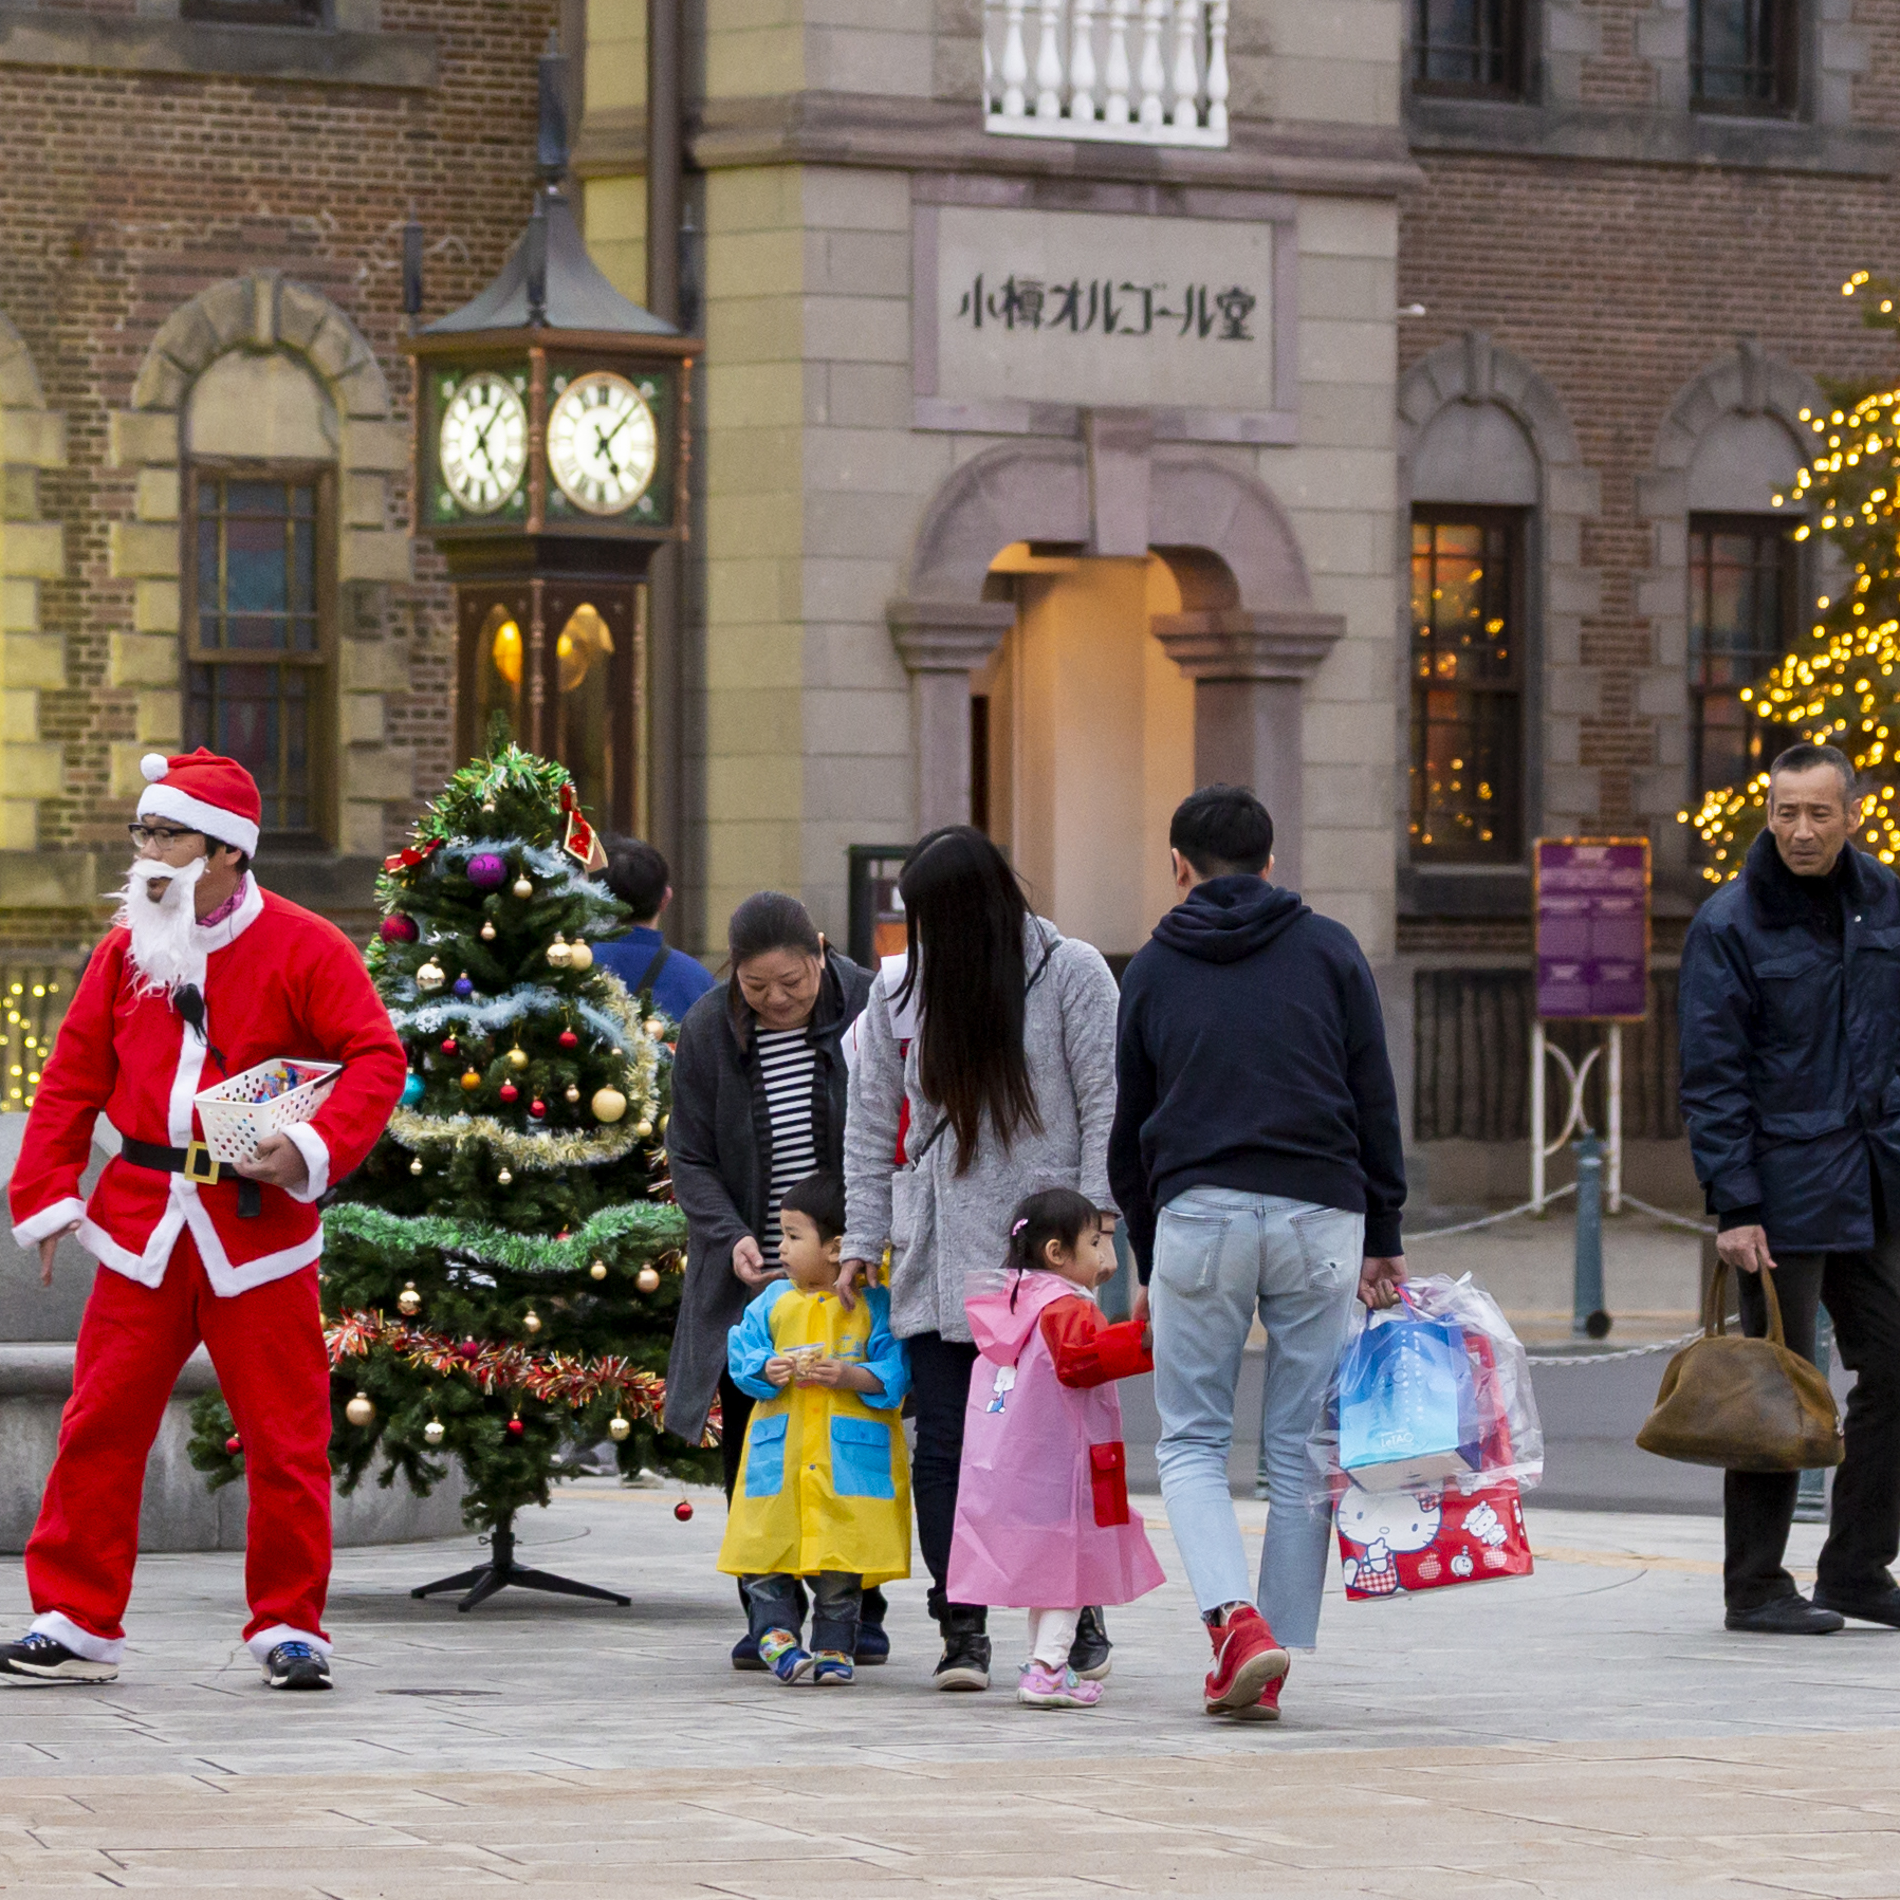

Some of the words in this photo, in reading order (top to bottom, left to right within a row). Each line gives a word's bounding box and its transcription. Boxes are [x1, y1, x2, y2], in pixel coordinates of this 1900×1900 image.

[957, 272, 1257, 342] 小樽オルゴール堂
[1381, 1433, 1414, 1447] LeTAO
